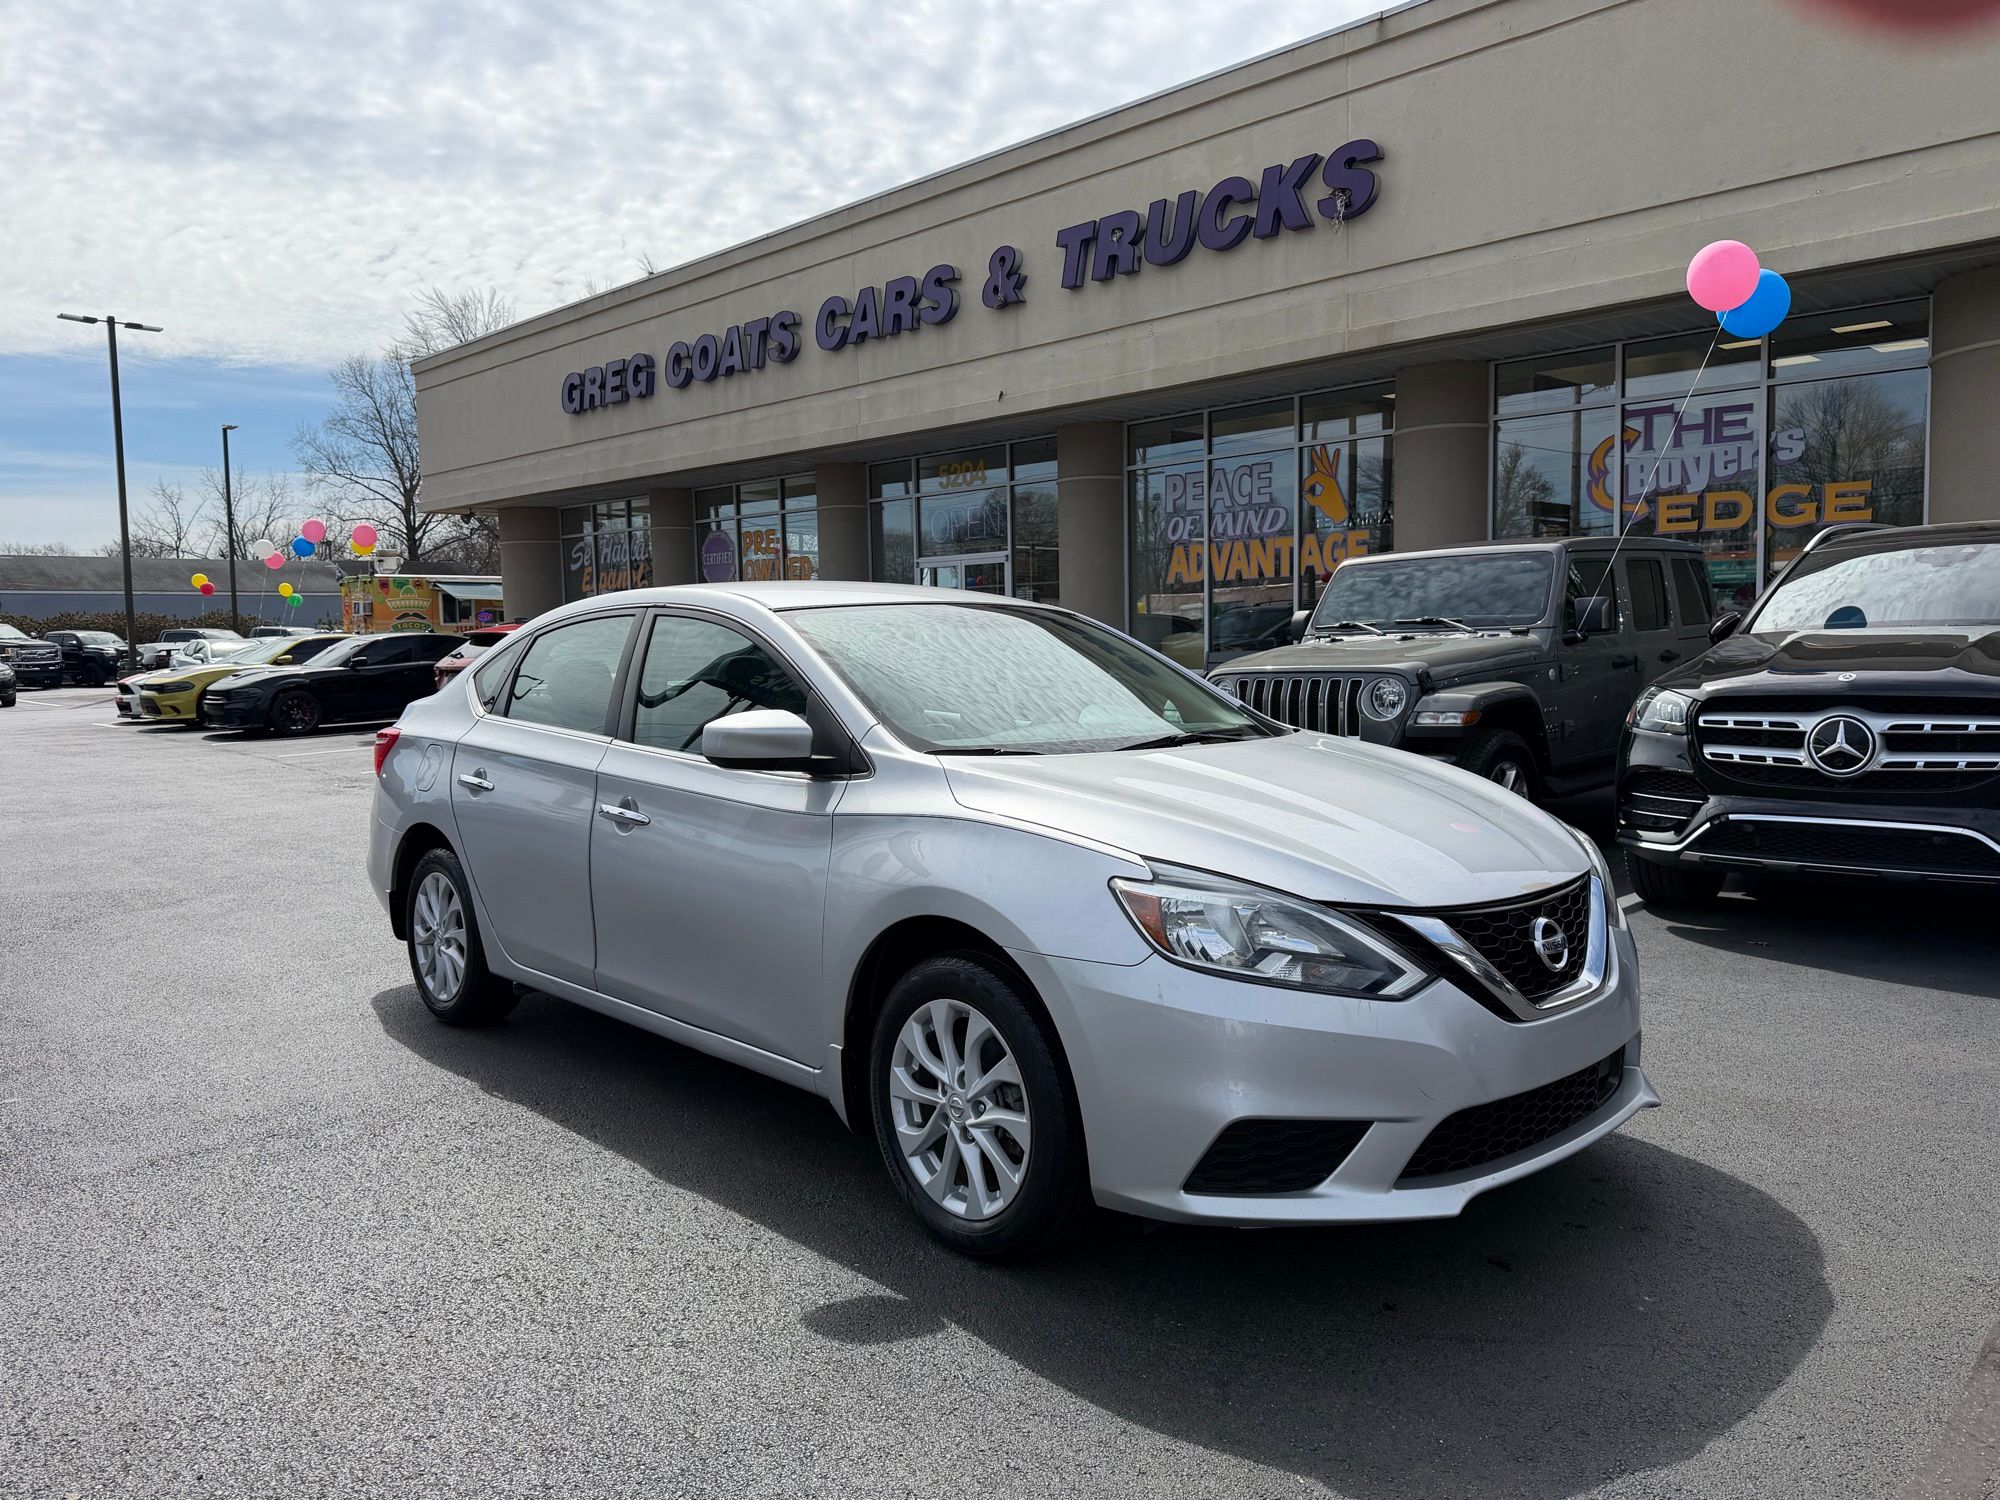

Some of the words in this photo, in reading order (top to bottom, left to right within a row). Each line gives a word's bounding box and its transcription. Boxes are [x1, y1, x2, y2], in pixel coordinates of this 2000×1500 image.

[562, 353, 655, 414] GREG
[665, 311, 802, 388] COATS
[816, 264, 962, 351] CARS
[982, 245, 1028, 309] &
[1056, 139, 1384, 289] TRUCKS
[1624, 403, 1754, 451] THE
[938, 459, 987, 489] 5204
[1165, 462, 1273, 513] PEACE
[931, 506, 1000, 543] OPEN
[1166, 515, 1200, 542] OF
[1210, 506, 1288, 538] MIND
[1655, 480, 1873, 534] EDGE
[570, 541, 592, 571] Se
[703, 552, 734, 565] CERTIFIED
[1166, 529, 1370, 584] ADVANTAGE
[397, 622, 426, 630] TACOS
